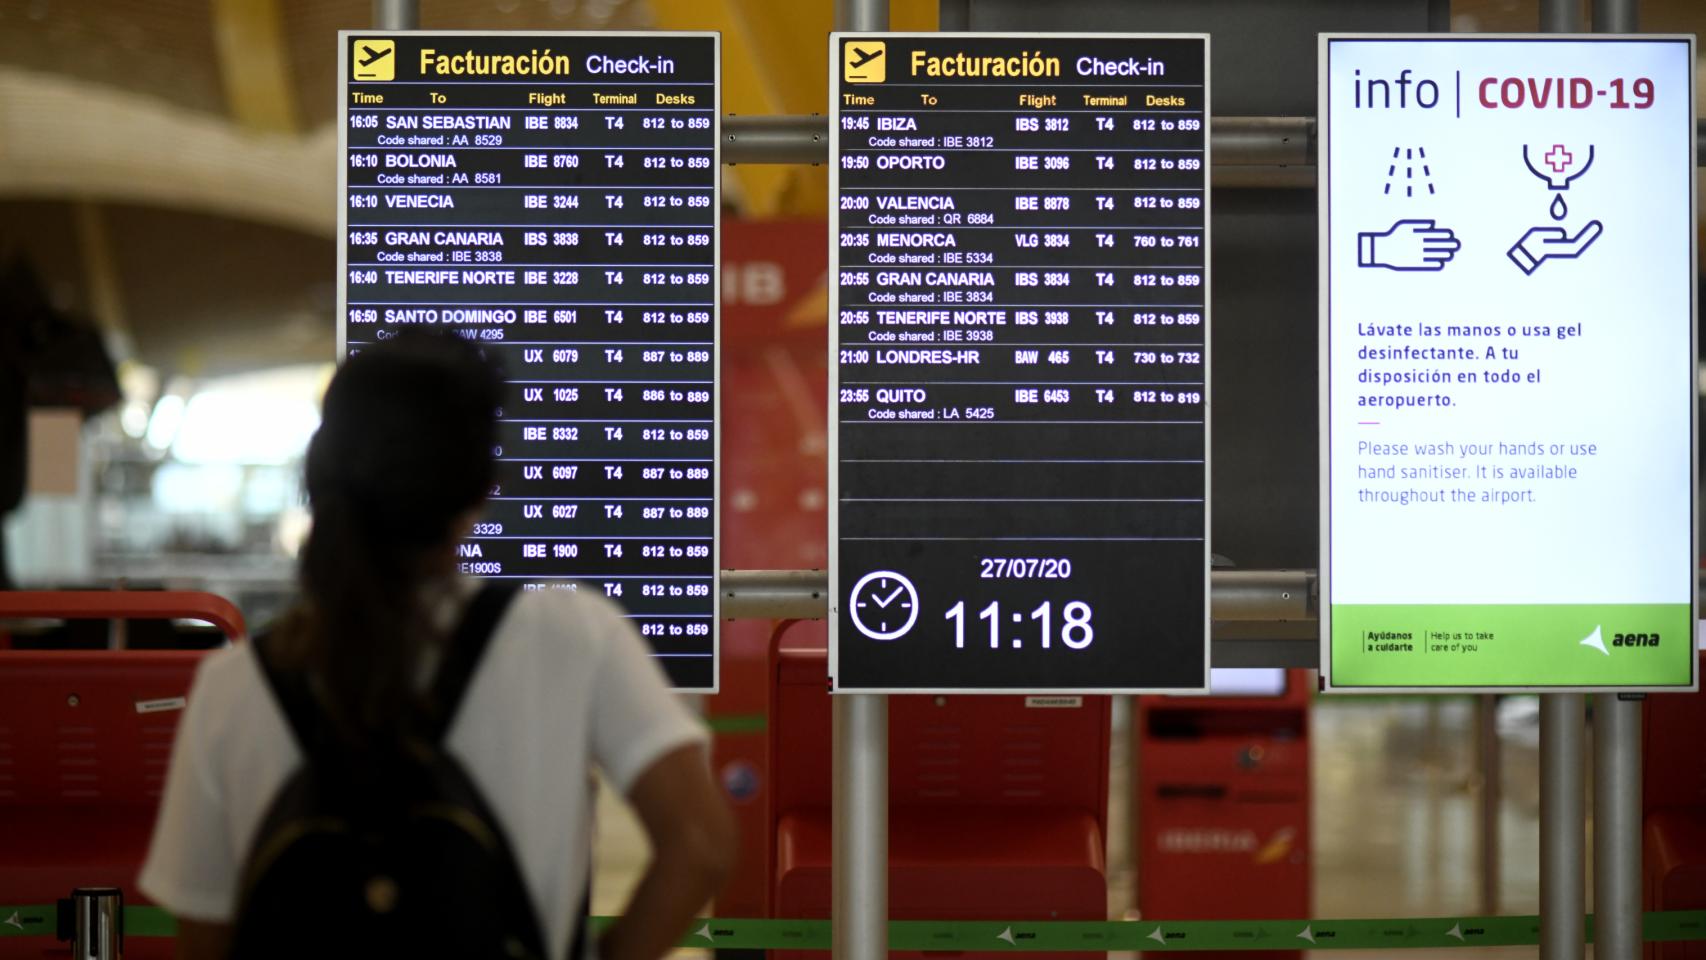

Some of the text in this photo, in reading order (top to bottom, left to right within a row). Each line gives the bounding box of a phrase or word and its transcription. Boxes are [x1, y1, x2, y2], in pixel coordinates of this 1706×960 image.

[420, 48, 675, 75] Facturación Check-in
[911, 50, 1165, 77] Facturación Check-in
[1354, 69, 1439, 109] info
[1478, 77, 1655, 110] COVID-19
[351, 92, 696, 107] Time To Flight Terminal Desks
[842, 93, 1186, 109] Time To Flight Terminal Desks
[349, 114, 711, 130] 16:05 SAN SEBASTIAN IBE 8834 T4 812 to 859
[840, 116, 1201, 132] 19:45 IBIZA IBS 3812 T4 812 to 859
[377, 134, 406, 145] Code
[407, 134, 444, 146] shared
[451, 134, 470, 146] AA
[474, 134, 503, 146] 8529
[868, 136, 897, 147] Code
[898, 136, 935, 147] shared
[943, 136, 964, 148] IBE
[966, 136, 994, 148] 3812
[349, 153, 711, 169] 16:10 BOLONIA IBE 8760 T4 812 to 859
[349, 230, 710, 247] 16:35 GRAN CANARIA IBS 3838 T4 812 to 859
[840, 232, 1200, 248] 20:35 MENORCA VLG 3834 T4 760 to 761
[868, 252, 897, 264] Code
[898, 252, 935, 264] shared
[943, 252, 963, 264] IBE
[965, 252, 994, 264] 5334
[348, 308, 710, 324] 16:50 SANTO DOMINGO IBE 6501 T4 812 to 859
[1358, 322, 1582, 340] Lávate las manos o usa gel
[523, 348, 710, 364] UX 6079 T4 887 to 889
[1358, 345, 1519, 360] desinfectante. A tu
[1358, 368, 1541, 386] disposición en todo el
[839, 387, 1201, 404] 23:55 QUITO IBE 6453 T4 812 to 819
[1357, 394, 1456, 410] aeropuerto.
[867, 408, 897, 420] Code
[897, 408, 935, 420] shared
[942, 407, 960, 419] LA
[965, 407, 995, 419] 5425
[1358, 440, 1597, 459] Please wash your hands or use
[1358, 464, 1578, 479] hand sanitiser. It is available
[1357, 487, 1536, 506] throughout the airport.
[980, 557, 1072, 579] 27/07/20
[944, 600, 1094, 650] 11:18
[1367, 631, 1413, 642] Ayúdanos
[1430, 631, 1451, 641] Help
[1464, 632, 1474, 640] to
[1475, 632, 1494, 641] take
[1612, 633, 1660, 647] aena
[1367, 643, 1413, 652] a cuidarte
[1430, 642, 1478, 654] care of you
